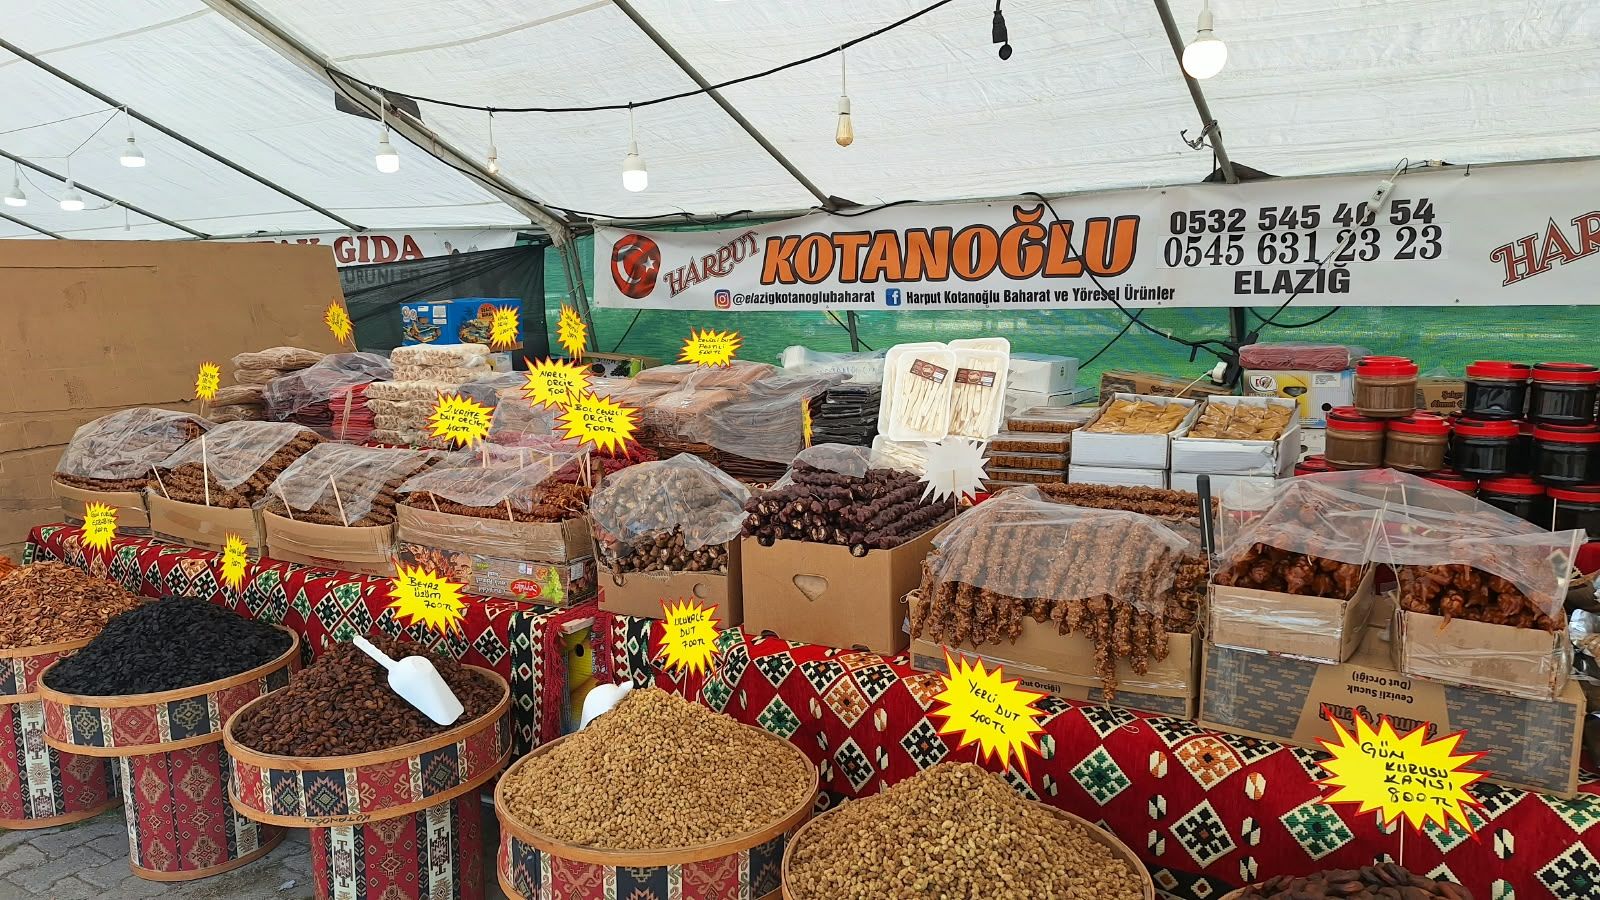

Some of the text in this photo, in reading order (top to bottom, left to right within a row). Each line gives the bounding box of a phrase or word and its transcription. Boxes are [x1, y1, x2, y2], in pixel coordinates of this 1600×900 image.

[1170, 208, 1247, 235] 0532
[1257, 204, 1321, 231] 545
[1389, 197, 1436, 225] 54
[333, 234, 425, 263] GIDA
[760, 203, 1141, 285] KOTANOĞLU
[1163, 224, 1442, 267] 0545 631 23 23
[663, 229, 761, 298] HARPUT
[1233, 262, 1351, 295] ELAZIĞ
[906, 283, 1176, 306] Harput Kotanoğlu Baharat ve Yöresel Ürünler
[680, 625, 695, 638] DUT
[1034, 679, 1061, 693] Orciği)
[1351, 670, 1411, 691] (Dut Orciği)
[1346, 683, 1414, 704] Cevizli Sucuk
[995, 704, 1020, 721] DUT
[1361, 741, 1405, 760] GÜN
[1385, 761, 1448, 778] KURUSU
[1384, 775, 1452, 791] KAYISI
